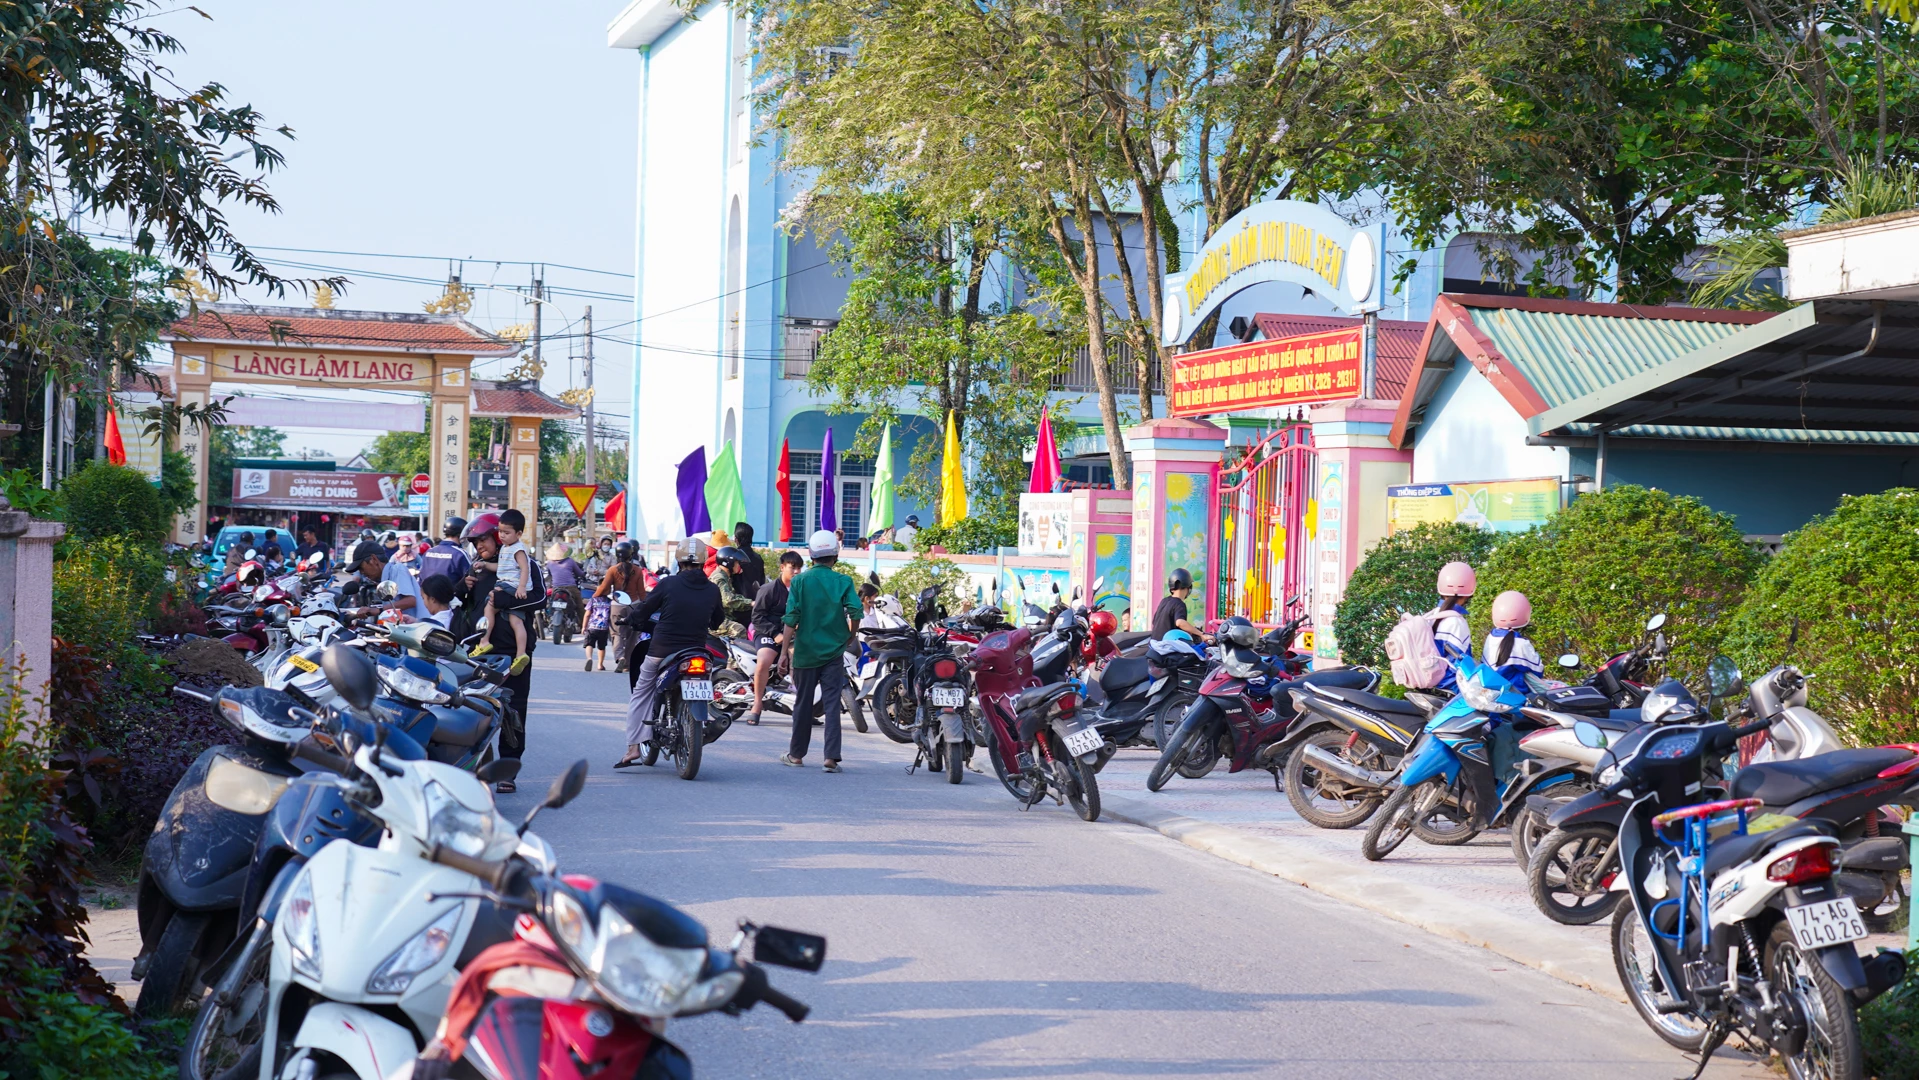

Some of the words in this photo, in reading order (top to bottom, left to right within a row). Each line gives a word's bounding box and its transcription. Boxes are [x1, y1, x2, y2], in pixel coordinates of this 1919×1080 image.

[1260, 221, 1287, 262] NON
[1288, 222, 1313, 270] HOA
[1314, 233, 1346, 290] SEN
[1295, 342, 1313, 368] QUỐC
[1313, 343, 1326, 367] HỘI
[1326, 340, 1345, 362] KHÓA
[1345, 341, 1358, 360] XVI
[233, 351, 296, 375] LÀNG
[300, 354, 349, 378] LÂM
[353, 361, 414, 381] LANG
[1258, 377, 1270, 397] CÁC
[1271, 372, 1283, 395] CẤP
[1284, 372, 1305, 396] NHIỆM
[1315, 372, 1331, 390] 2026
[289, 485, 322, 498] ĐẶNG
[324, 487, 358, 498] DUNG
[415, 480, 430, 488] STOP
[1396, 487, 1418, 496] THÔNG
[684, 690, 712, 699] 134.02
[685, 681, 708, 690] 74-AA
[1069, 730, 1094, 746] 74-K1
[1071, 737, 1102, 755] 076.01
[1797, 901, 1848, 926] 74-AG
[1800, 919, 1863, 946] 040.26
